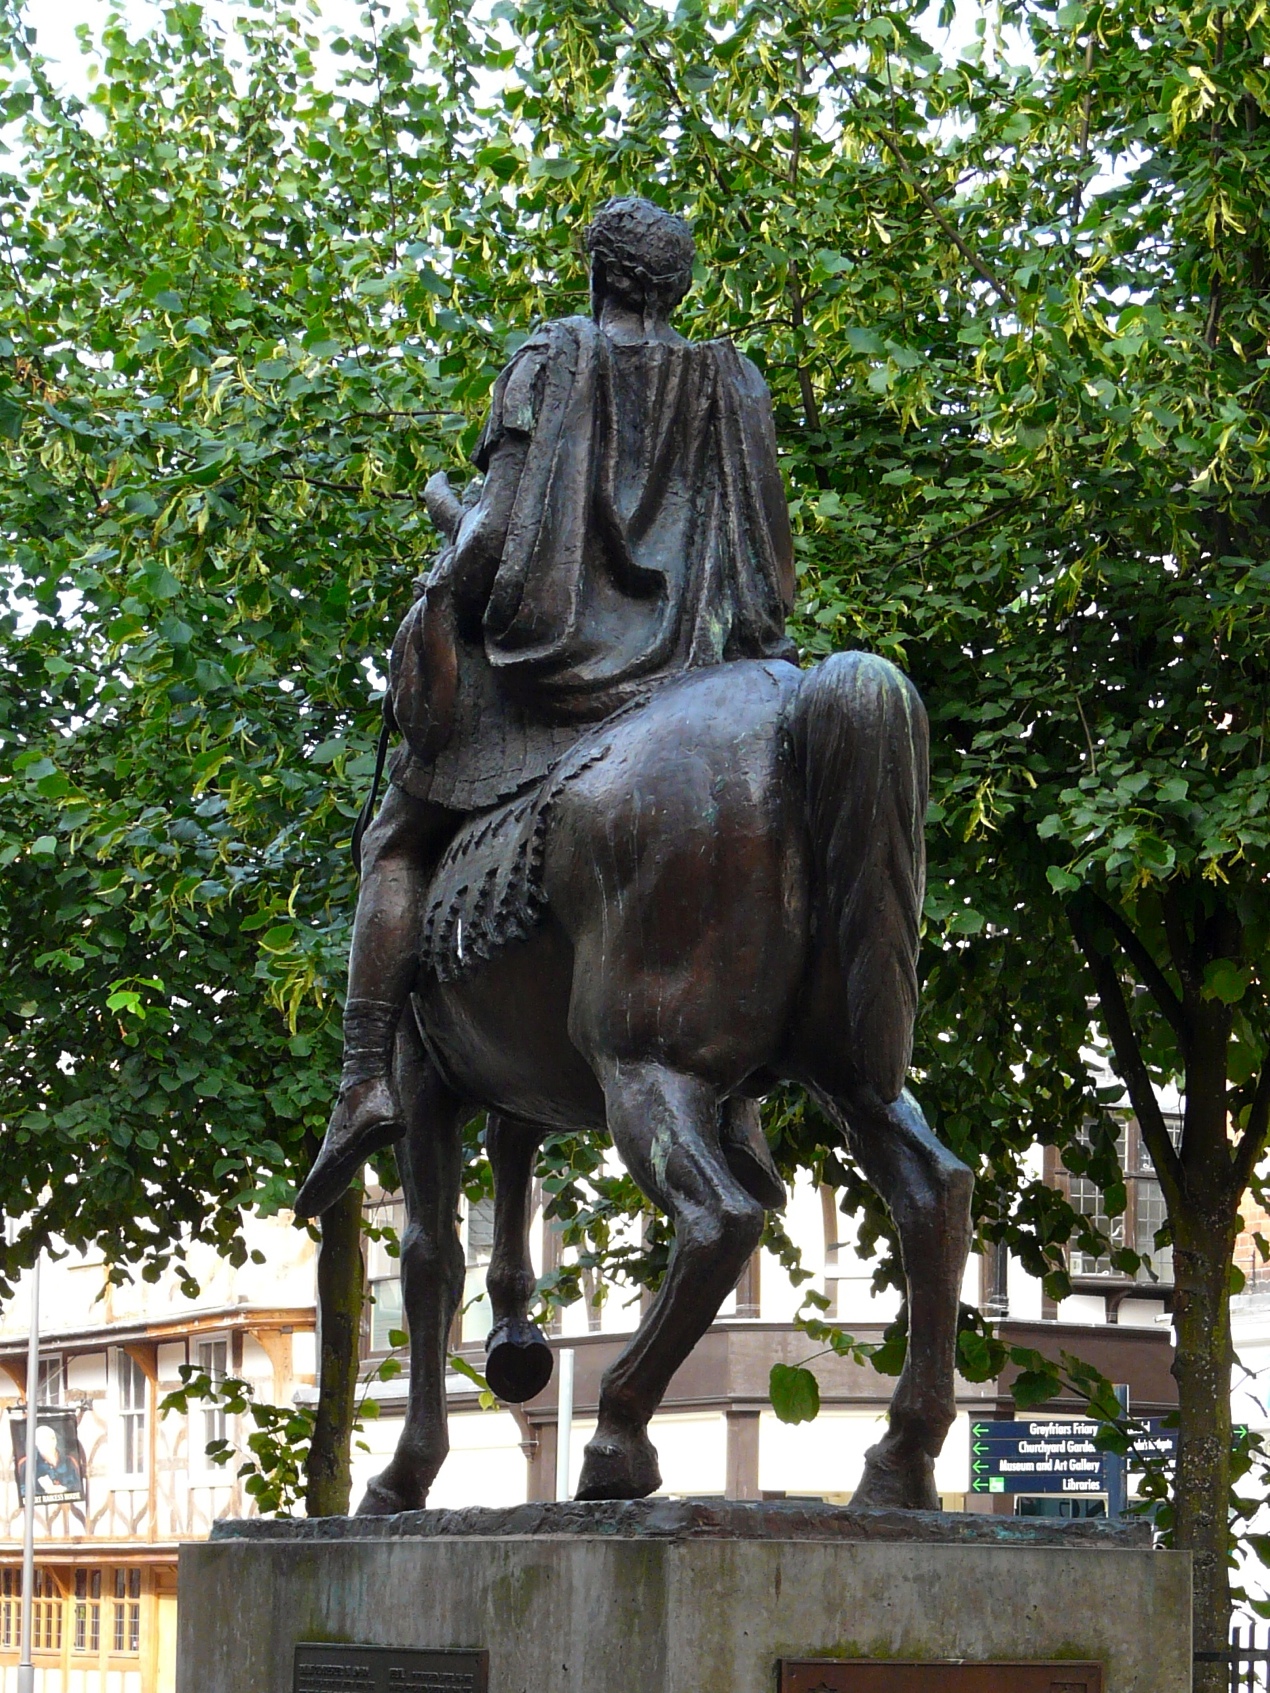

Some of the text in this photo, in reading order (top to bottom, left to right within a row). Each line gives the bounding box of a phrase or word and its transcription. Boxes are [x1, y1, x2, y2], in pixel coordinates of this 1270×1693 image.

[1029, 1422, 1099, 1438] Greyfriars Friary
[1018, 1440, 1066, 1456] Churchyard
[999, 1458, 1100, 1473] Museum and Art Gallery
[1062, 1478, 1100, 1491] Libraries
